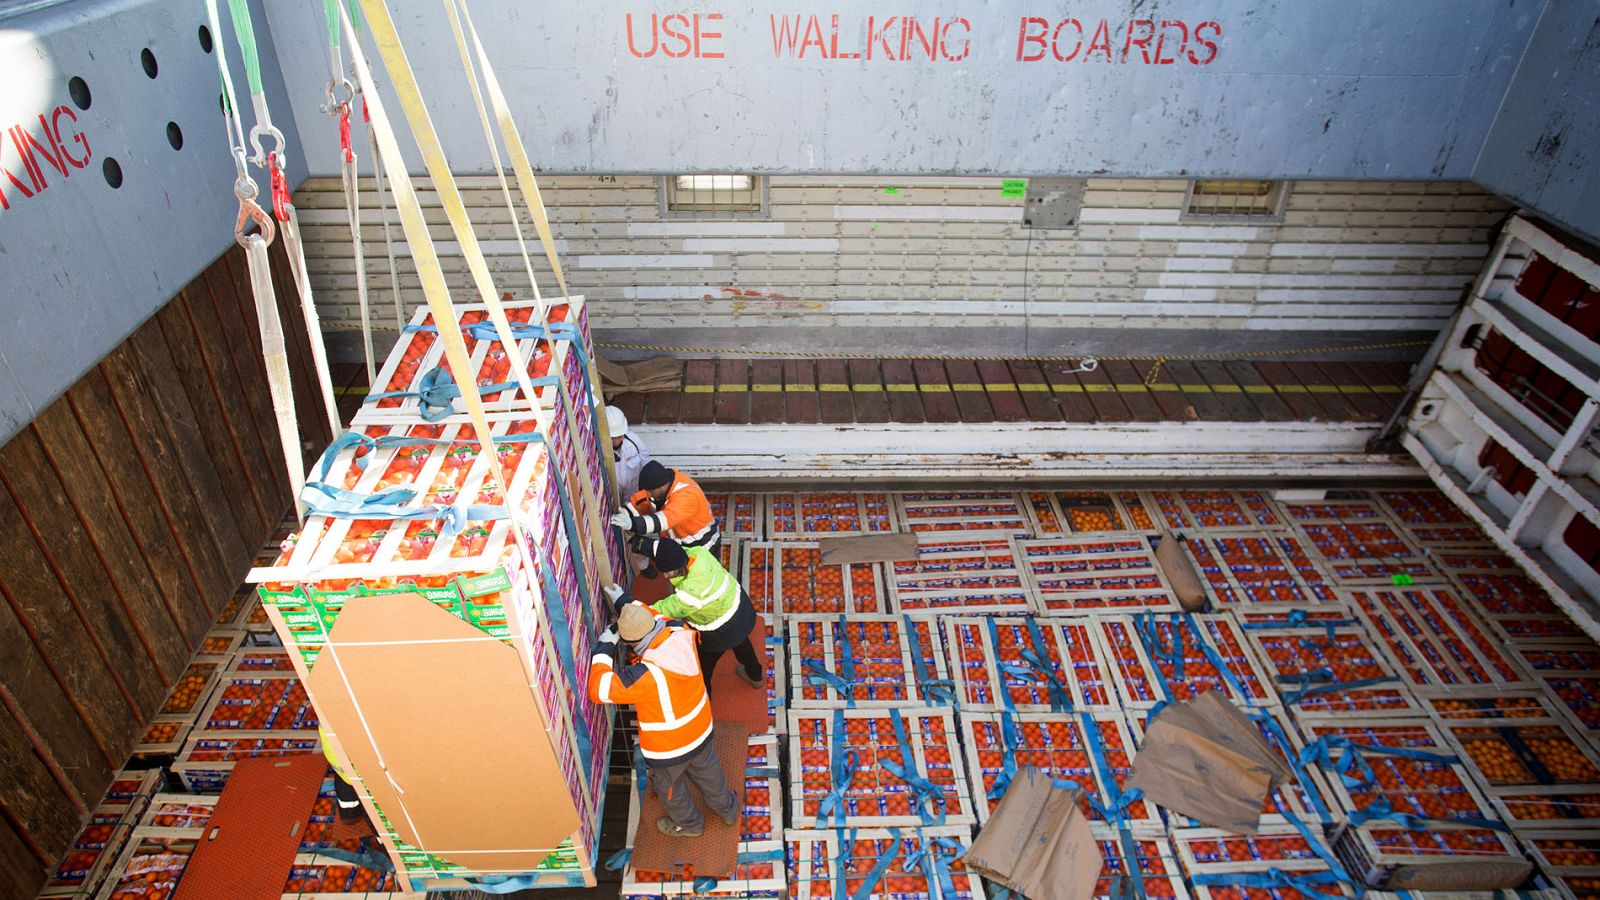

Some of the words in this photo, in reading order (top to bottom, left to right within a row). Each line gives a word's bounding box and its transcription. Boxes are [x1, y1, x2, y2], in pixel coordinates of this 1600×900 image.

[625, 13, 726, 59] USE
[770, 13, 972, 62] WALKING
[1016, 16, 1222, 65] BOARDS
